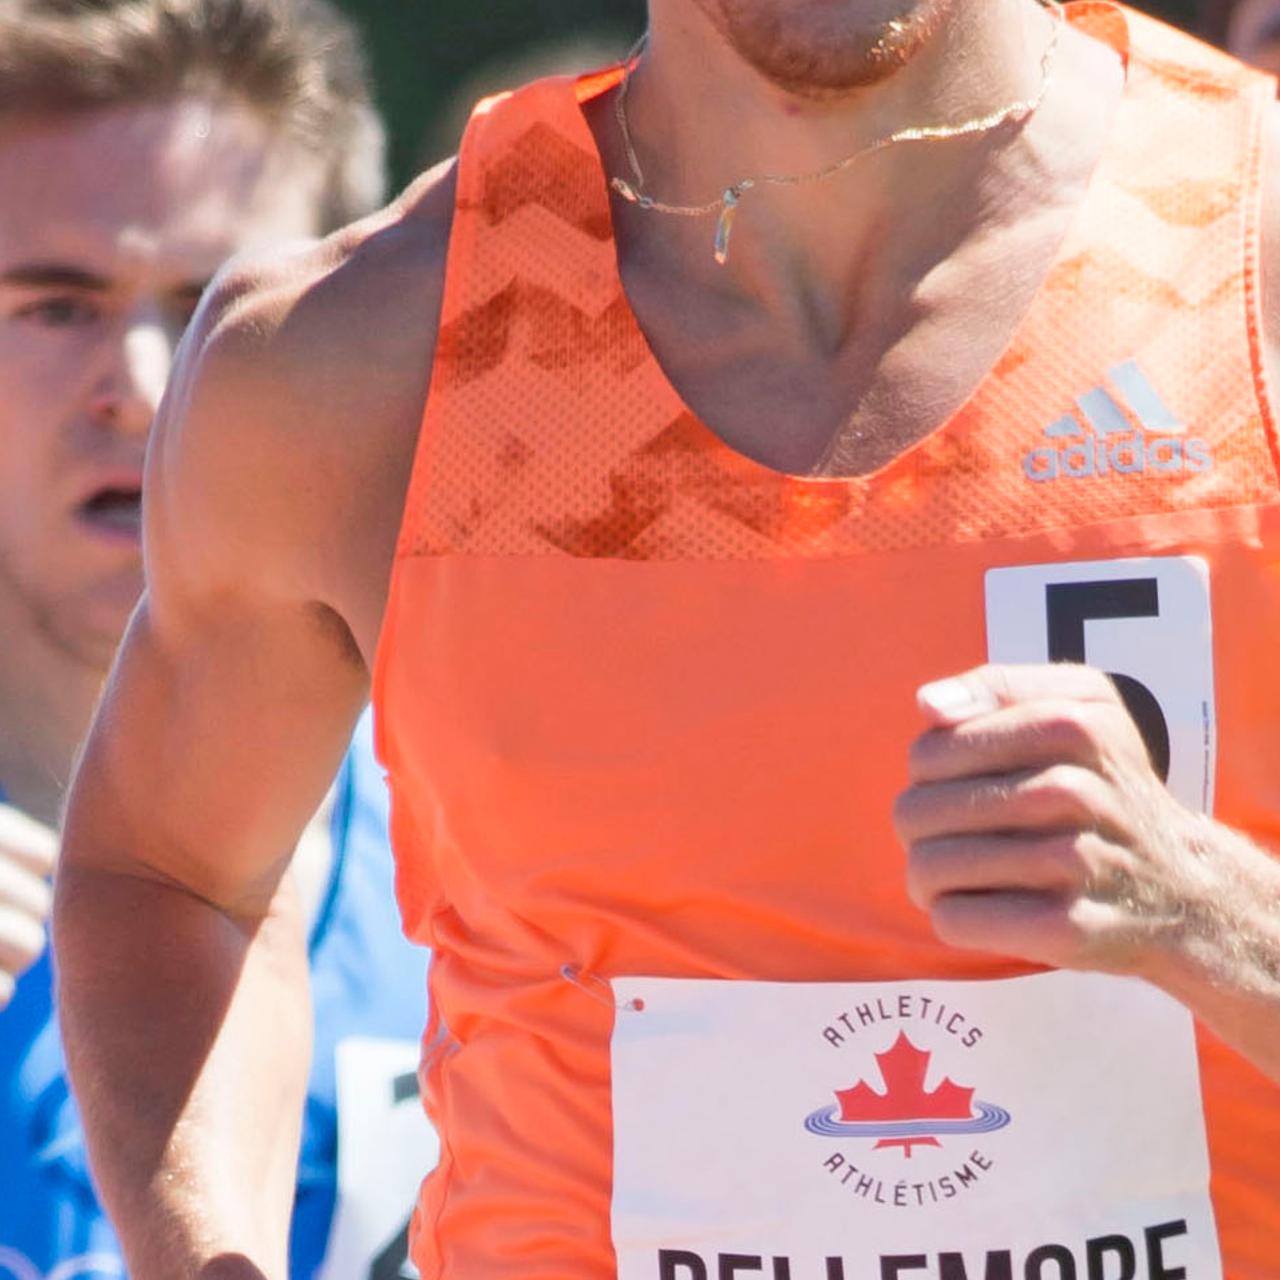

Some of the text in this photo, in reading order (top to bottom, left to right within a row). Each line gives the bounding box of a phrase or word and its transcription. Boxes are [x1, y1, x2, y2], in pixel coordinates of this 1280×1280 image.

[1023, 433, 1213, 483] adidas
[1045, 578, 1171, 785] 5
[822, 995, 984, 1048] ATHLETICS
[822, 1149, 994, 1207] ATHLÉTISME
